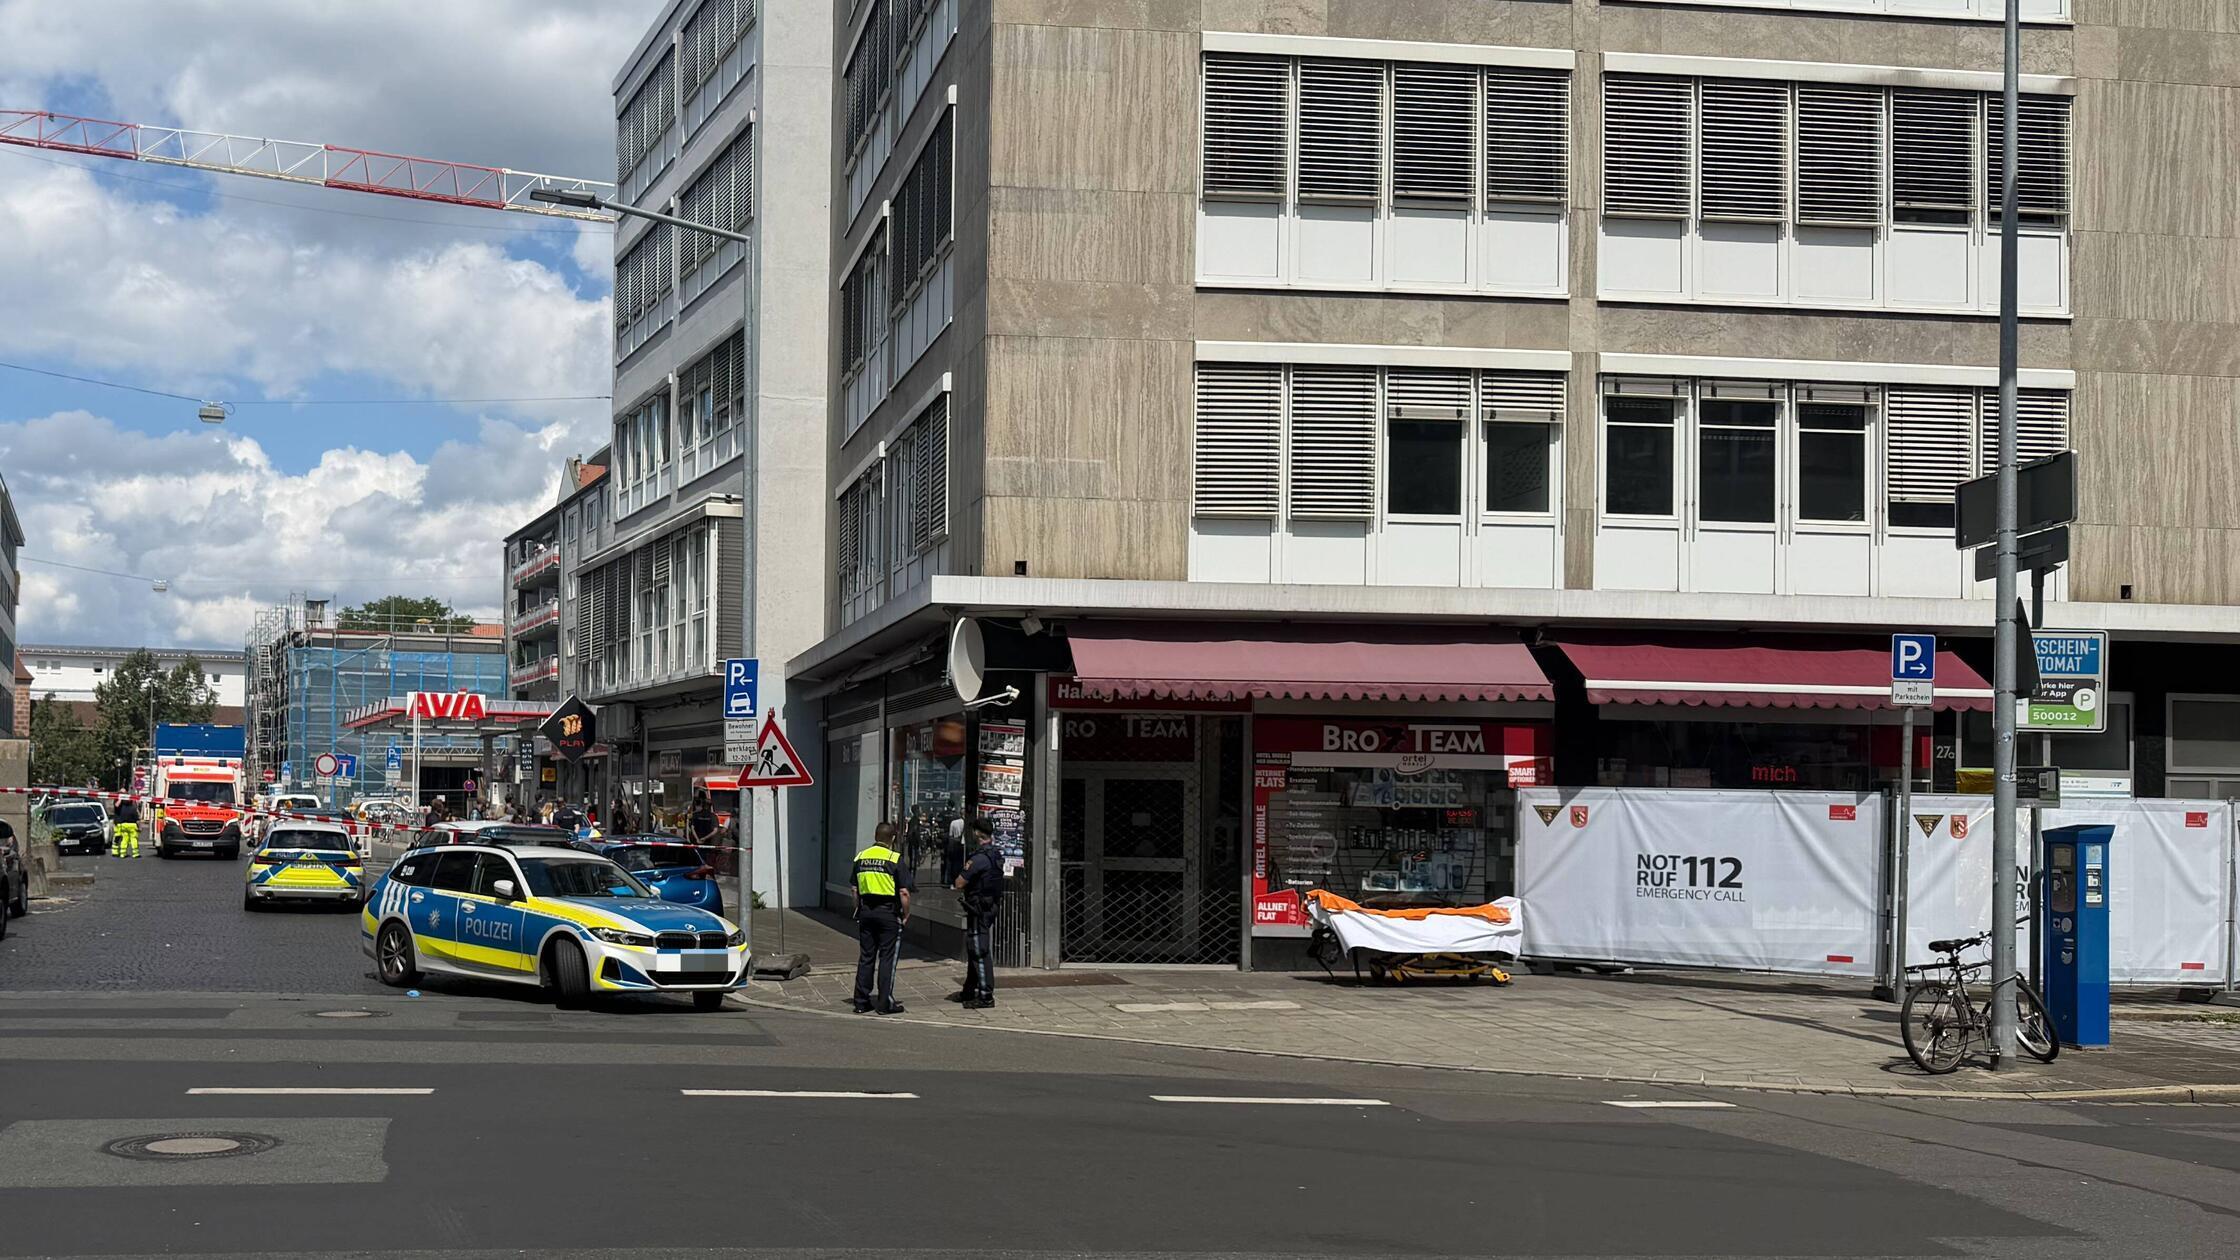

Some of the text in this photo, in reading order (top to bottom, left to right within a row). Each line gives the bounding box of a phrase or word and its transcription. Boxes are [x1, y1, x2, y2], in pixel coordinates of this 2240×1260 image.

[1899, 640, 1922, 674] P
[2039, 656, 2083, 672] TOMAT
[731, 662, 745, 686] P
[1907, 685, 1918, 693] mit
[2049, 690, 2067, 698] App
[408, 689, 486, 719] AVIA
[1894, 693, 1930, 702] Parkschein
[2033, 711, 2077, 721] 500012
[1064, 715, 1189, 738] RO TEAM
[559, 739, 586, 748] PLAY
[1936, 745, 1955, 760] 27a
[1509, 767, 1536, 776] SMART
[1751, 764, 1798, 783] mich
[1255, 777, 1286, 788] FLATS
[1256, 805, 1266, 878] ORTEL MOBILE
[1636, 853, 1682, 871] NOT
[1636, 870, 1678, 888] RUF
[1682, 855, 1743, 889] 112
[1636, 887, 1746, 902] EMERGENCY CALL
[1257, 902, 1288, 912] ALLNET
[1257, 911, 1277, 920] FLAT
[465, 917, 513, 941] POLIZEI
